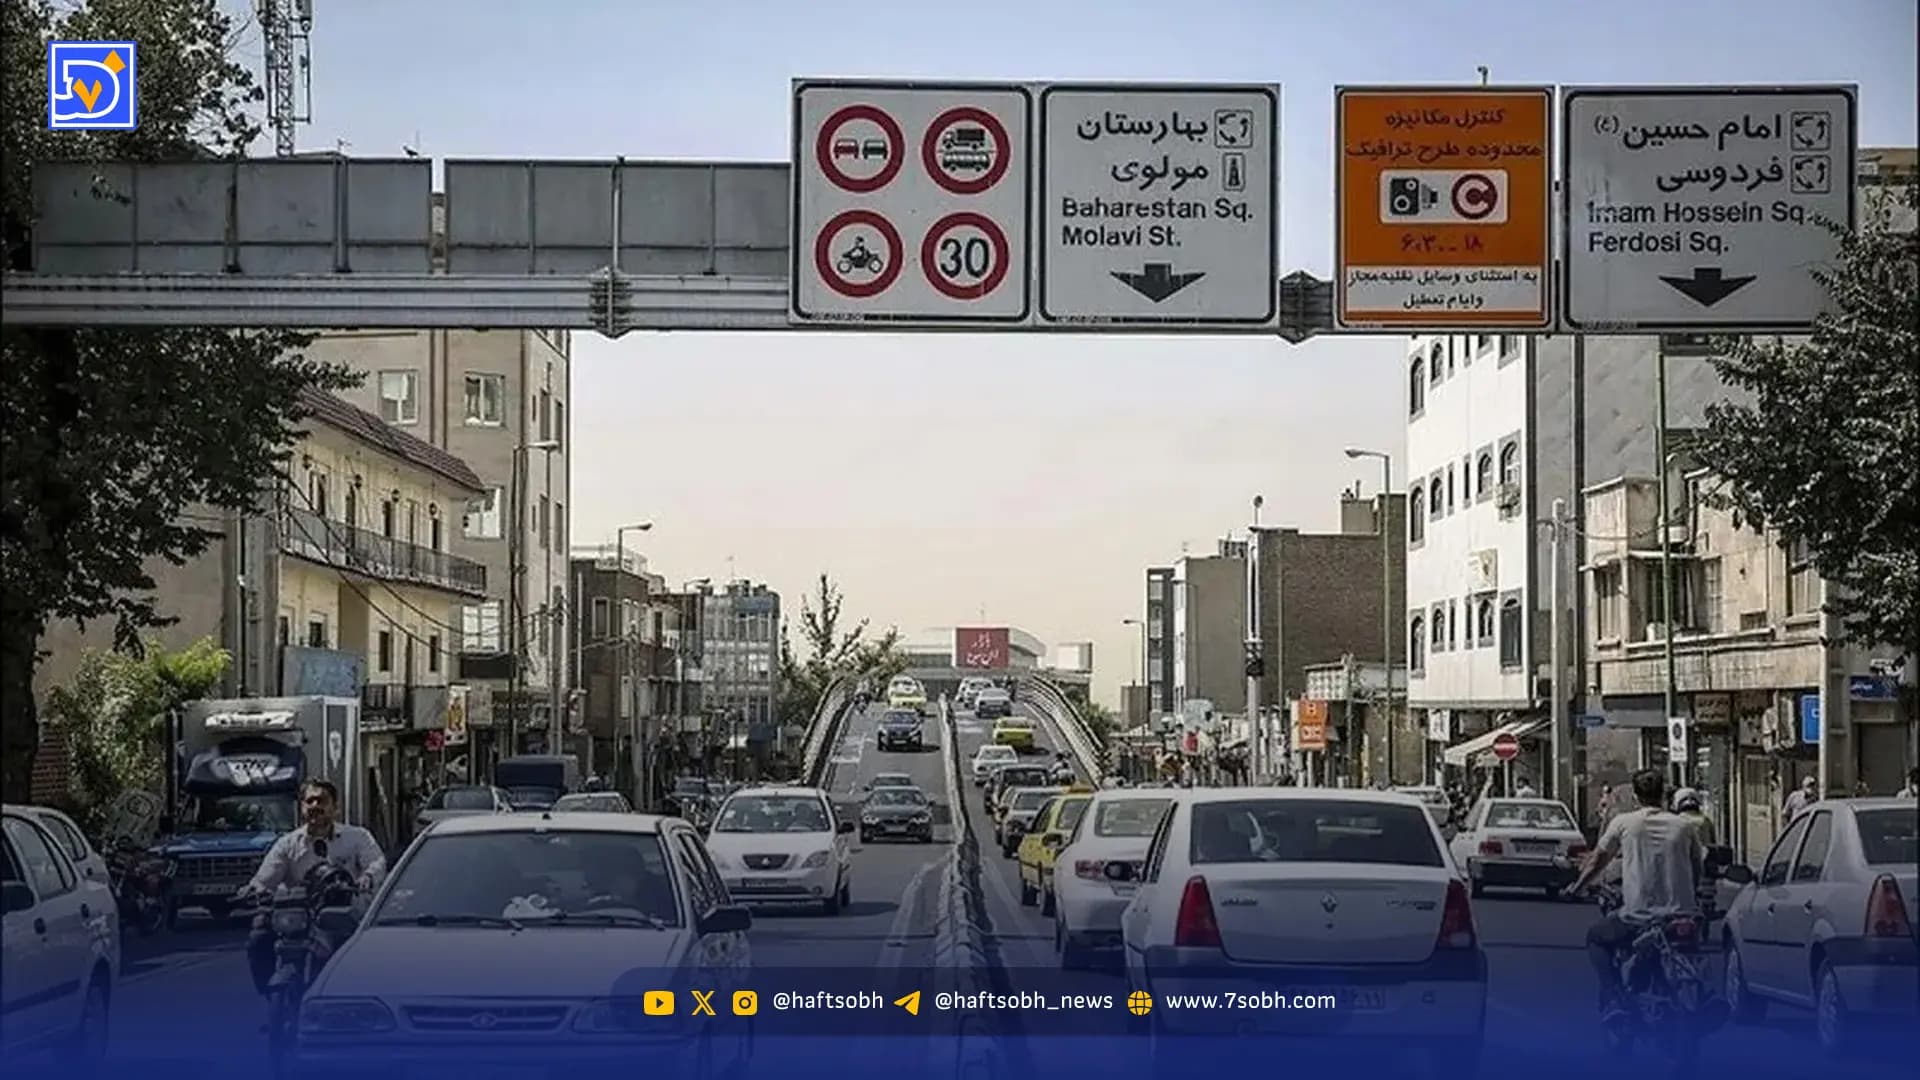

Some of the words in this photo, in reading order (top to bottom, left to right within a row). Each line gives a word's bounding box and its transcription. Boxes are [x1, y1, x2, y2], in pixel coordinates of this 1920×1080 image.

[1077, 111, 1209, 145] بهارستان
[1385, 108, 1451, 130] مکانیزه
[1455, 108, 1506, 130] کنترل
[1623, 123, 1710, 150] حسین
[1717, 114, 1782, 151] امام
[1346, 139, 1413, 162] ترافیک
[1417, 140, 1460, 164] طرح
[1466, 144, 1543, 161] محدوده
[1111, 155, 1209, 191] مولوی
[1656, 156, 1784, 193] فردوسی
[1062, 197, 1207, 219] Baharestan
[1214, 197, 1254, 223] Sq.
[1588, 201, 1656, 223] Imam
[1664, 201, 1763, 223] Hossein
[1062, 225, 1142, 246] Molavi
[1149, 225, 1182, 247] St.
[1589, 231, 1681, 253] Ferdosi
[1689, 231, 1729, 255] Sq.
[939, 238, 990, 279] 30
[1418, 270, 1460, 286] وسایل
[1465, 270, 1518, 284] استثنای
[1523, 271, 1538, 285] به
[1403, 293, 1445, 309] تعطیل
